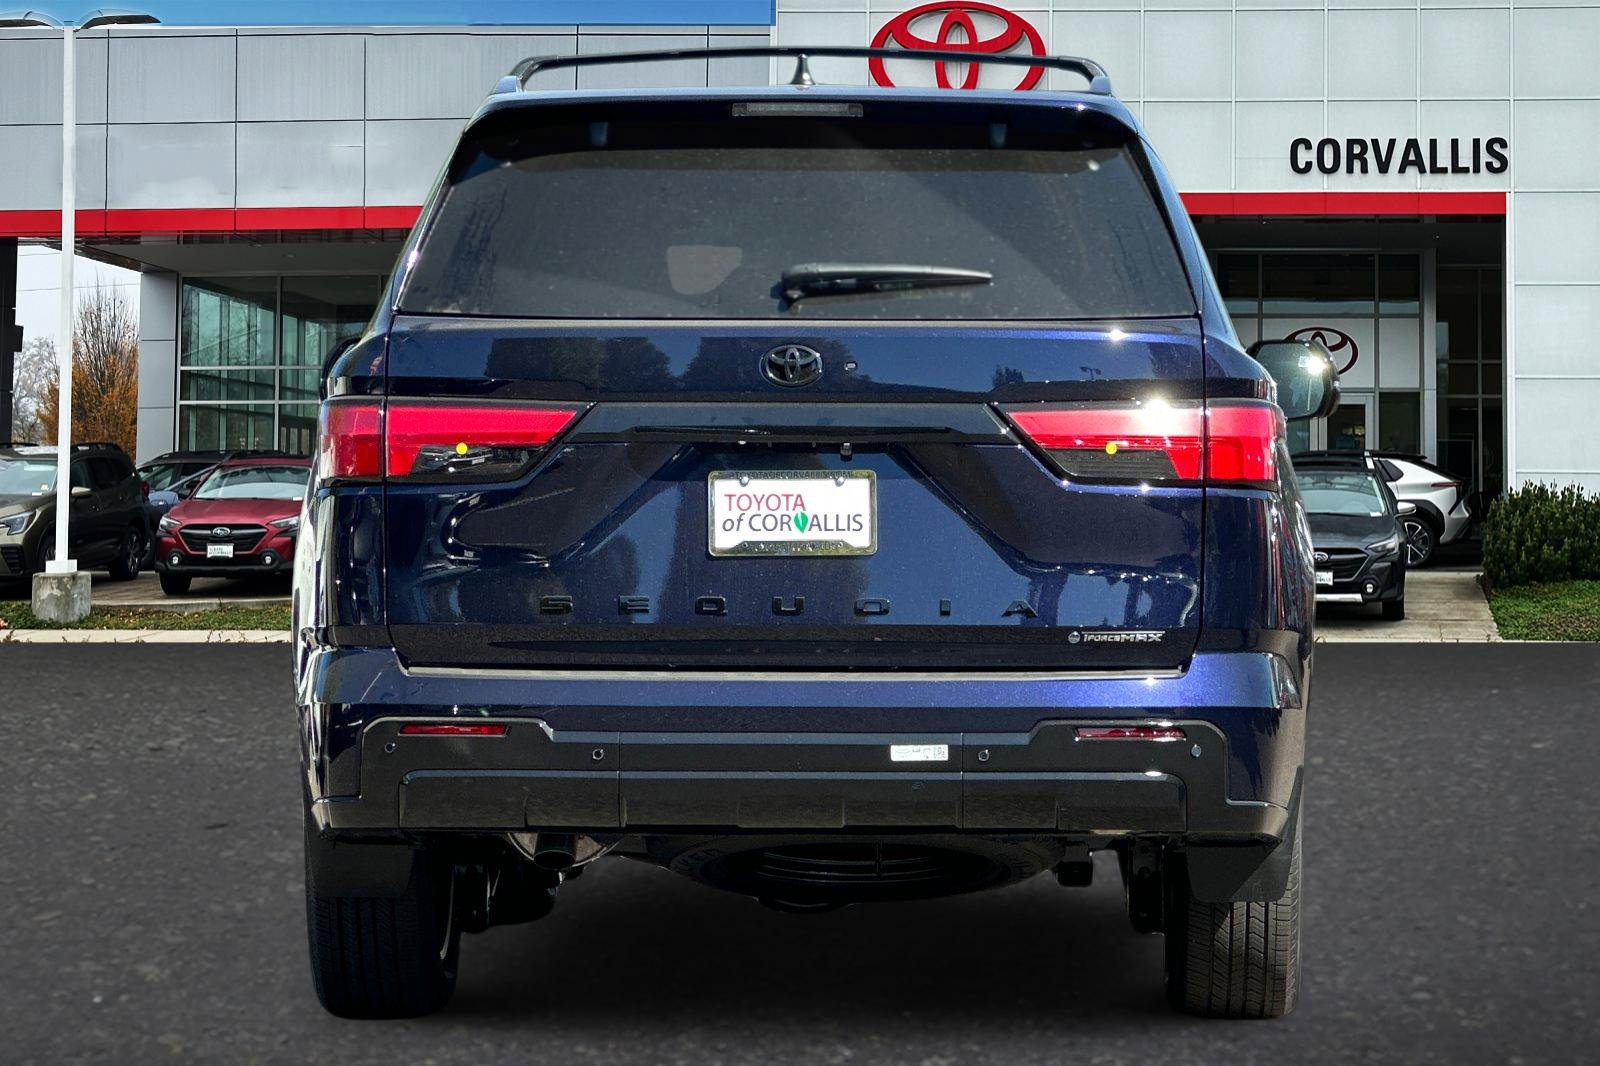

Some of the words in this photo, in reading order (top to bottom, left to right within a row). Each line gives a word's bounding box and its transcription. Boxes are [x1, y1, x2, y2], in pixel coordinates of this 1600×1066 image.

[1289, 137, 1509, 175] CORVALLIS
[724, 493, 807, 512] TOYOTA
[722, 512, 745, 532] of
[748, 511, 864, 534] CORVALLIS
[539, 595, 1038, 617] SEQUOIA
